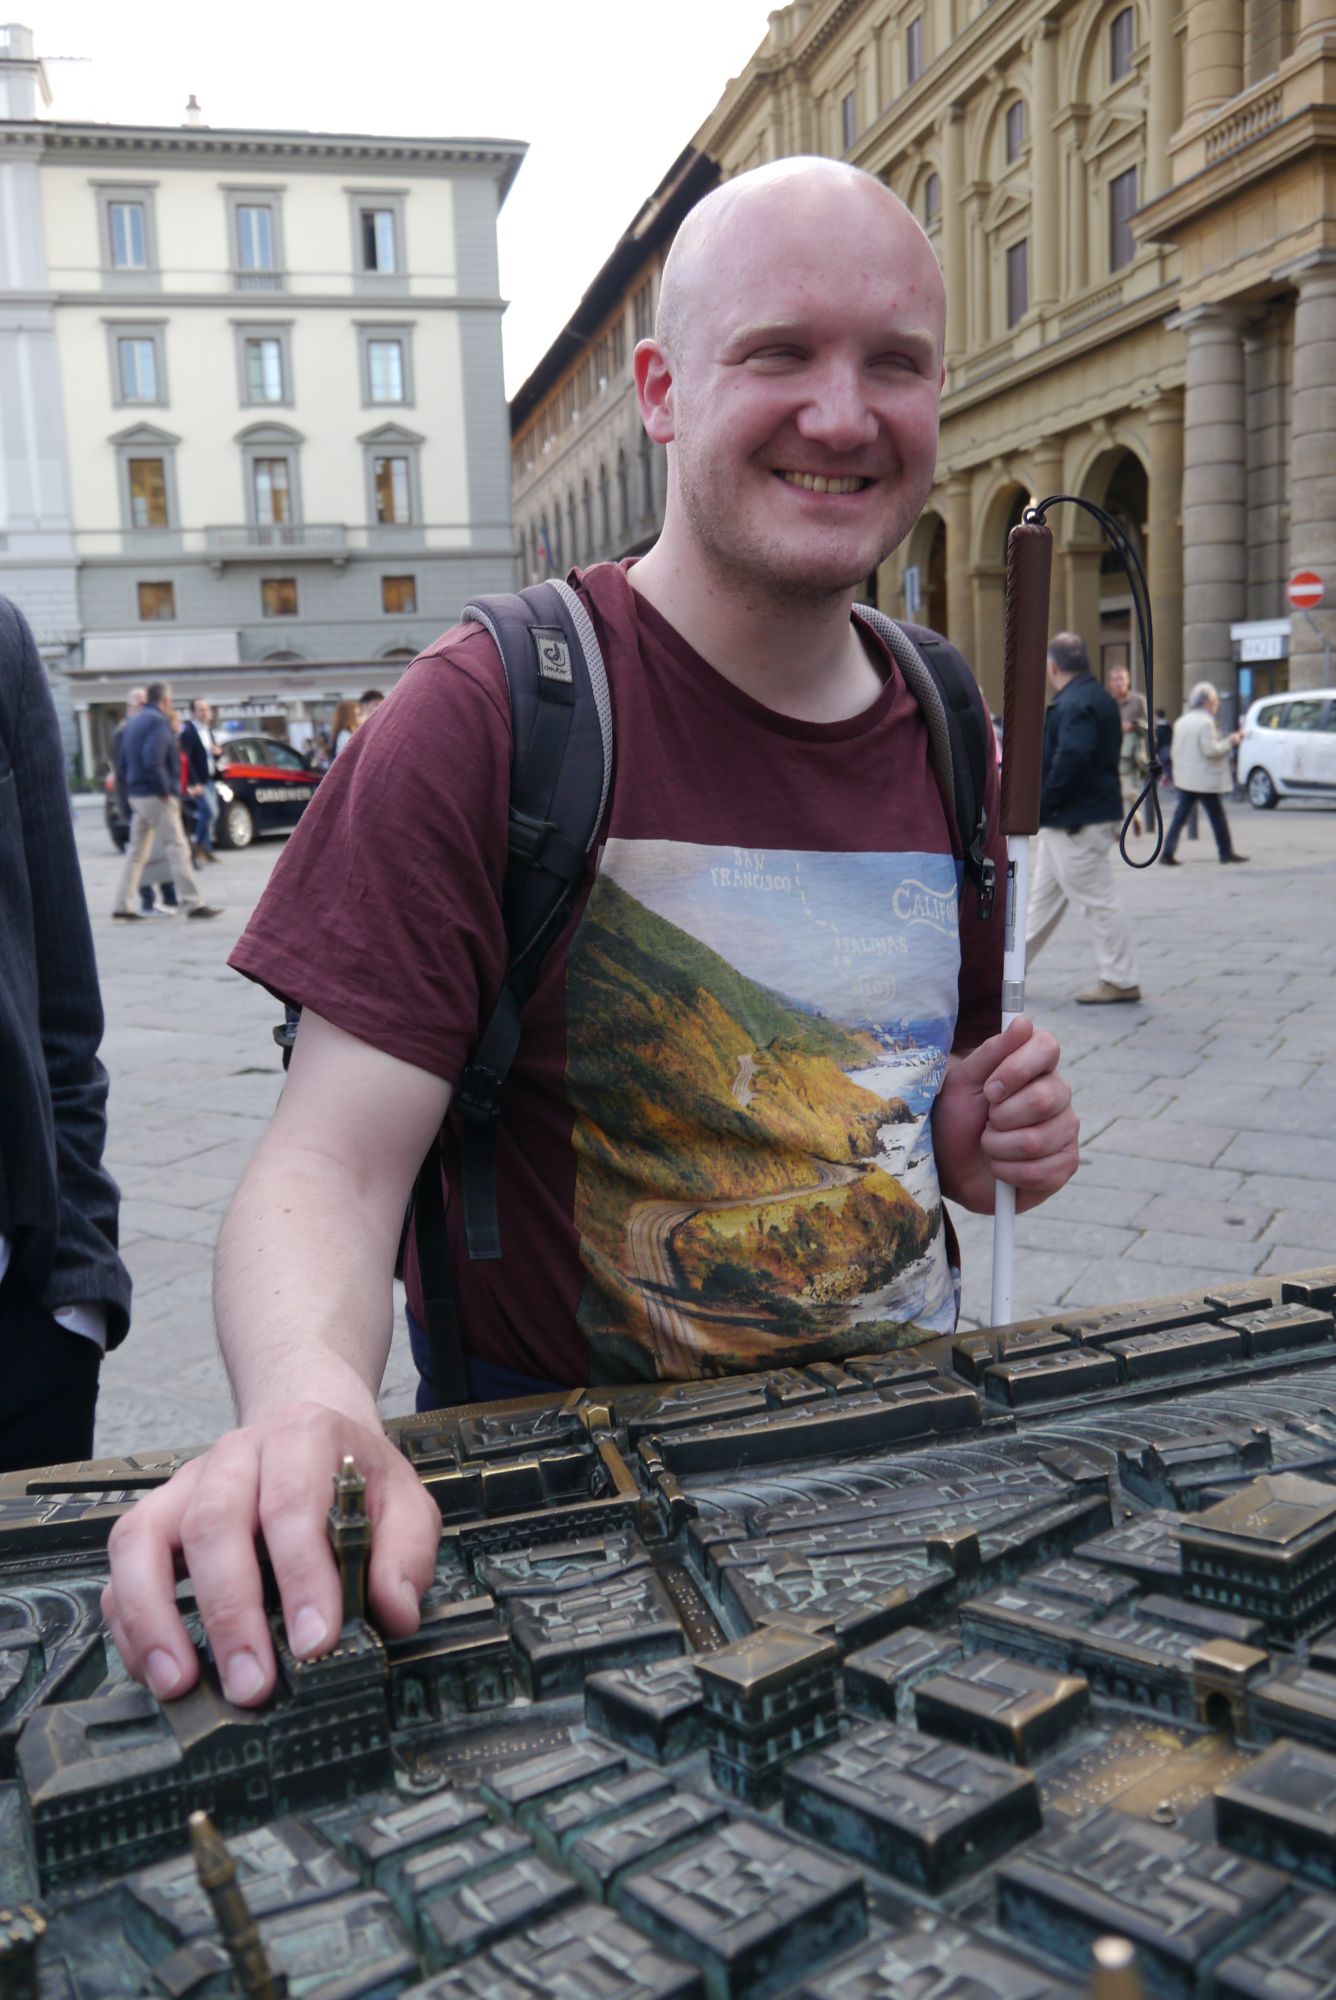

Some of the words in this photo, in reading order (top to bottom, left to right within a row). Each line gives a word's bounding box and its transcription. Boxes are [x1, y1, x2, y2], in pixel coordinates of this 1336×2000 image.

[543, 664, 567, 675] deuter
[734, 848, 765, 871] SAN
[710, 866, 792, 892] FRANCISCO
[841, 935, 908, 955] SALINAS
